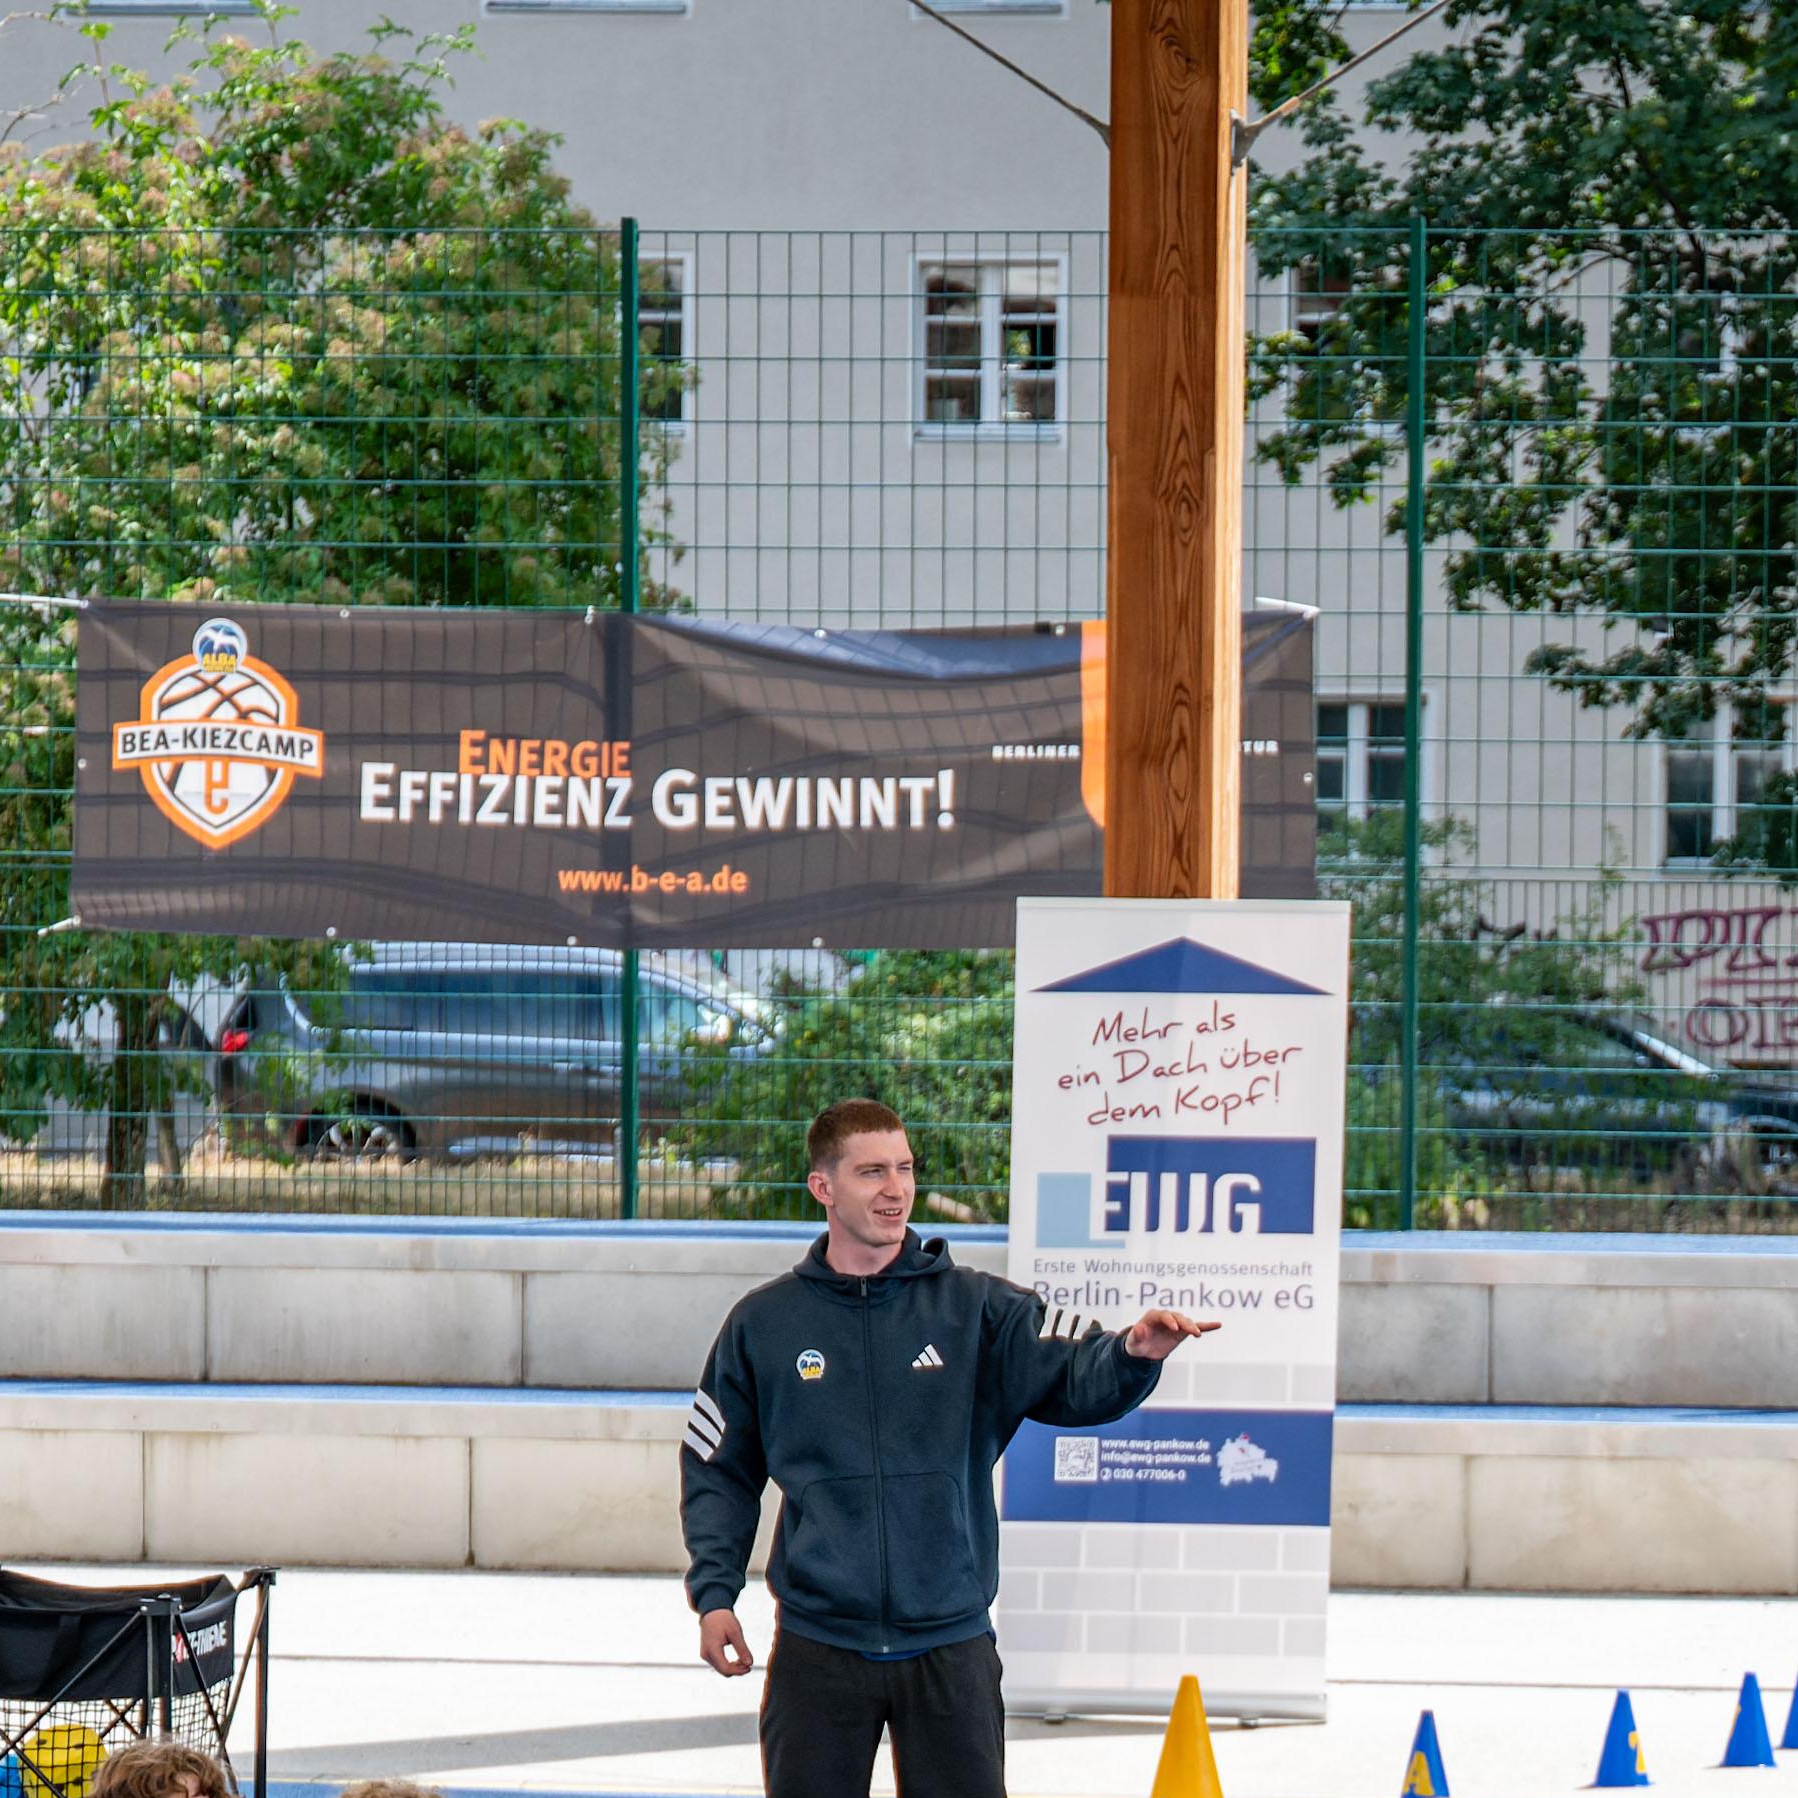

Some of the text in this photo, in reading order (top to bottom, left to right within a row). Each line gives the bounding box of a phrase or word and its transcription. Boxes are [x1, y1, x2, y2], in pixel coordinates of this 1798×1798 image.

[121, 727, 314, 759] BEA-KIEZCAMP
[992, 745, 1081, 759] BERLINER
[360, 761, 956, 831] EFFIZIENZ GEWINNT!
[558, 864, 748, 894] www.b-e-a.de
[1092, 999, 1237, 1046] Mehr als
[1058, 1038, 1303, 1090] ein Dach über
[1087, 1070, 1281, 1126] dem Kopf!
[1033, 1259, 1314, 1277] Erste Wohnungsgenossenschaft
[1033, 1280, 1314, 1310] Berlin-Pankow eG
[1102, 1438, 1210, 1451] www.ewg-pankow.de
[1102, 1451, 1211, 1464] info@ewg-pankow.de
[1402, 1751, 1435, 1797] A
